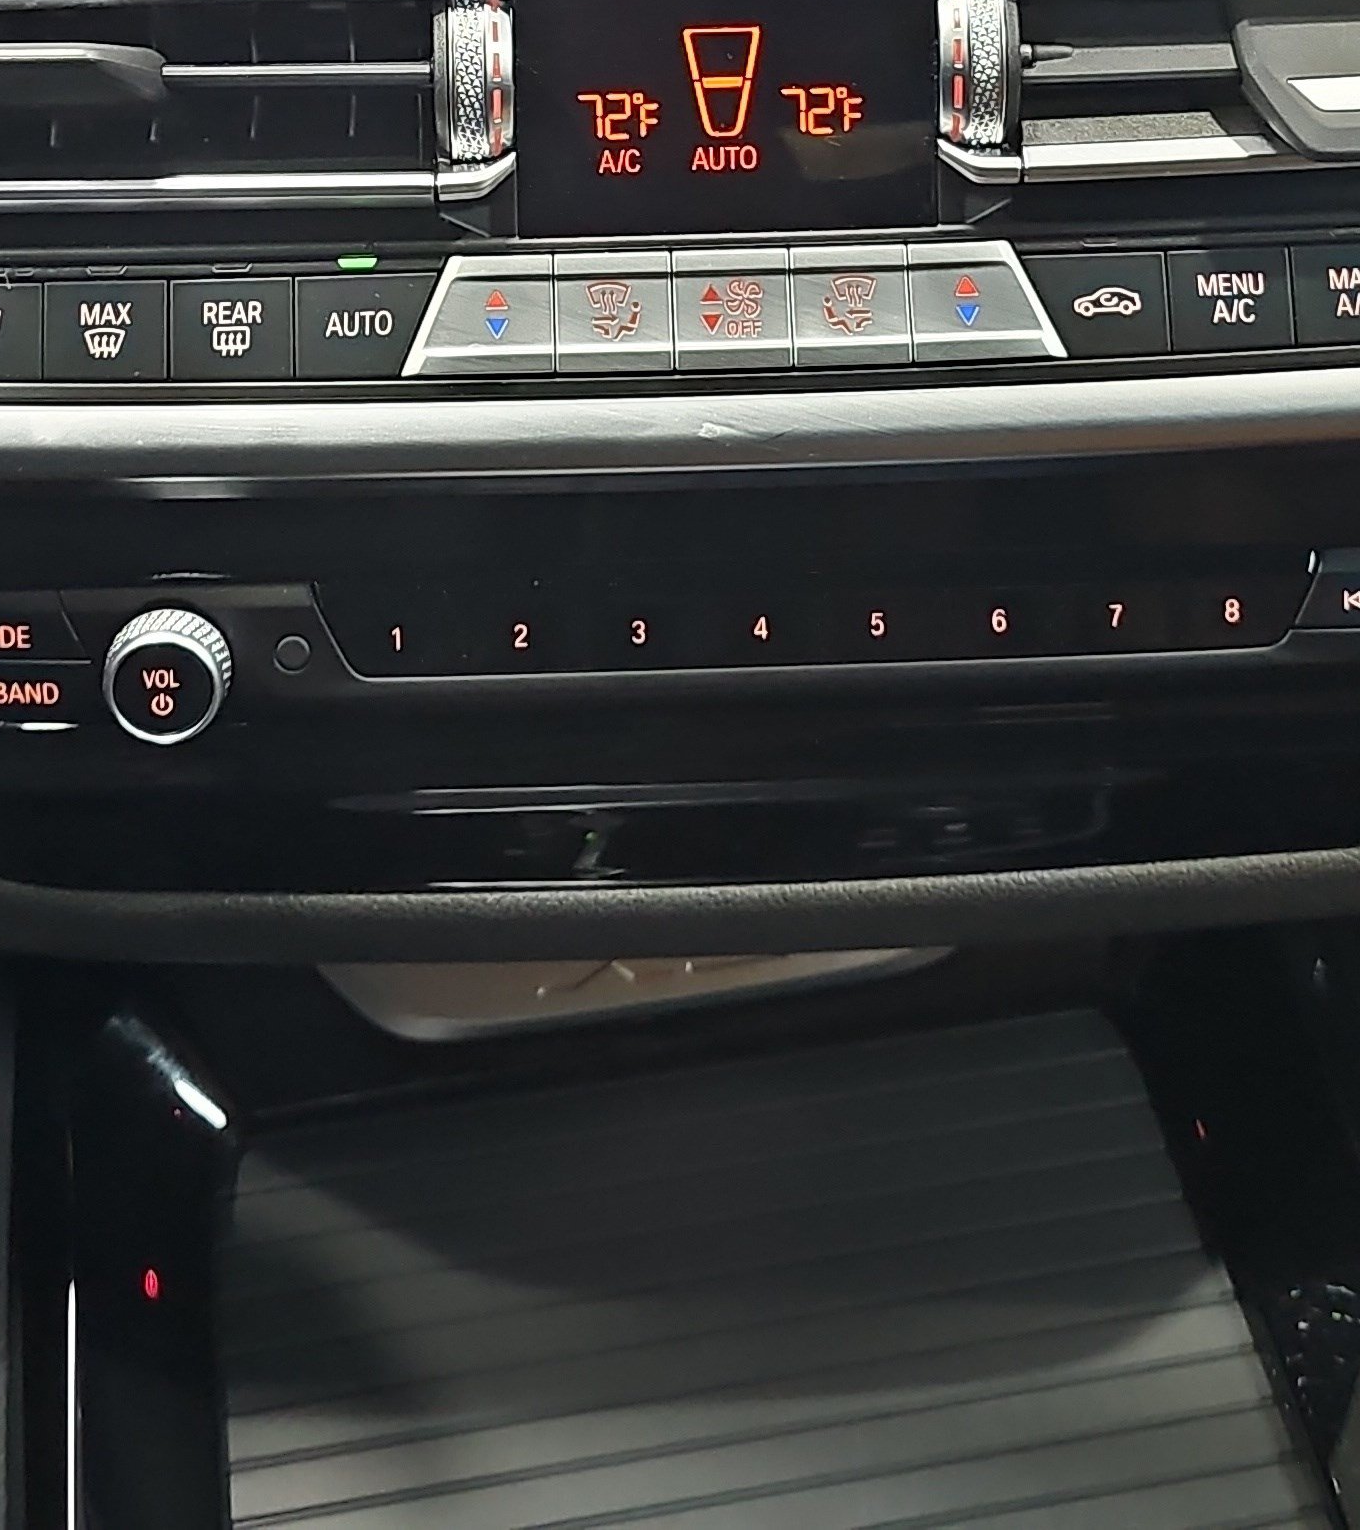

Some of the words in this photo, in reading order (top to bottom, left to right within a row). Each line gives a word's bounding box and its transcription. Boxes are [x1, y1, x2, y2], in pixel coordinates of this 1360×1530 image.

[599, 149, 641, 174] A/C
[692, 145, 758, 171] AUTO
[1196, 272, 1264, 297] MENU
[79, 302, 133, 327] MAX
[203, 300, 262, 325] REAR
[1212, 298, 1256, 324] A/C
[325, 310, 393, 338] AUTO
[725, 319, 763, 338] OFF
[991, 608, 1008, 634] 6
[1108, 604, 1124, 630] 7
[1224, 598, 1240, 624] 8
[513, 625, 528, 648] 2
[631, 621, 647, 645] 3
[753, 615, 770, 640] 4
[870, 611, 886, 637] 5
[391, 627, 403, 651] 1
[142, 669, 180, 689] VOL
